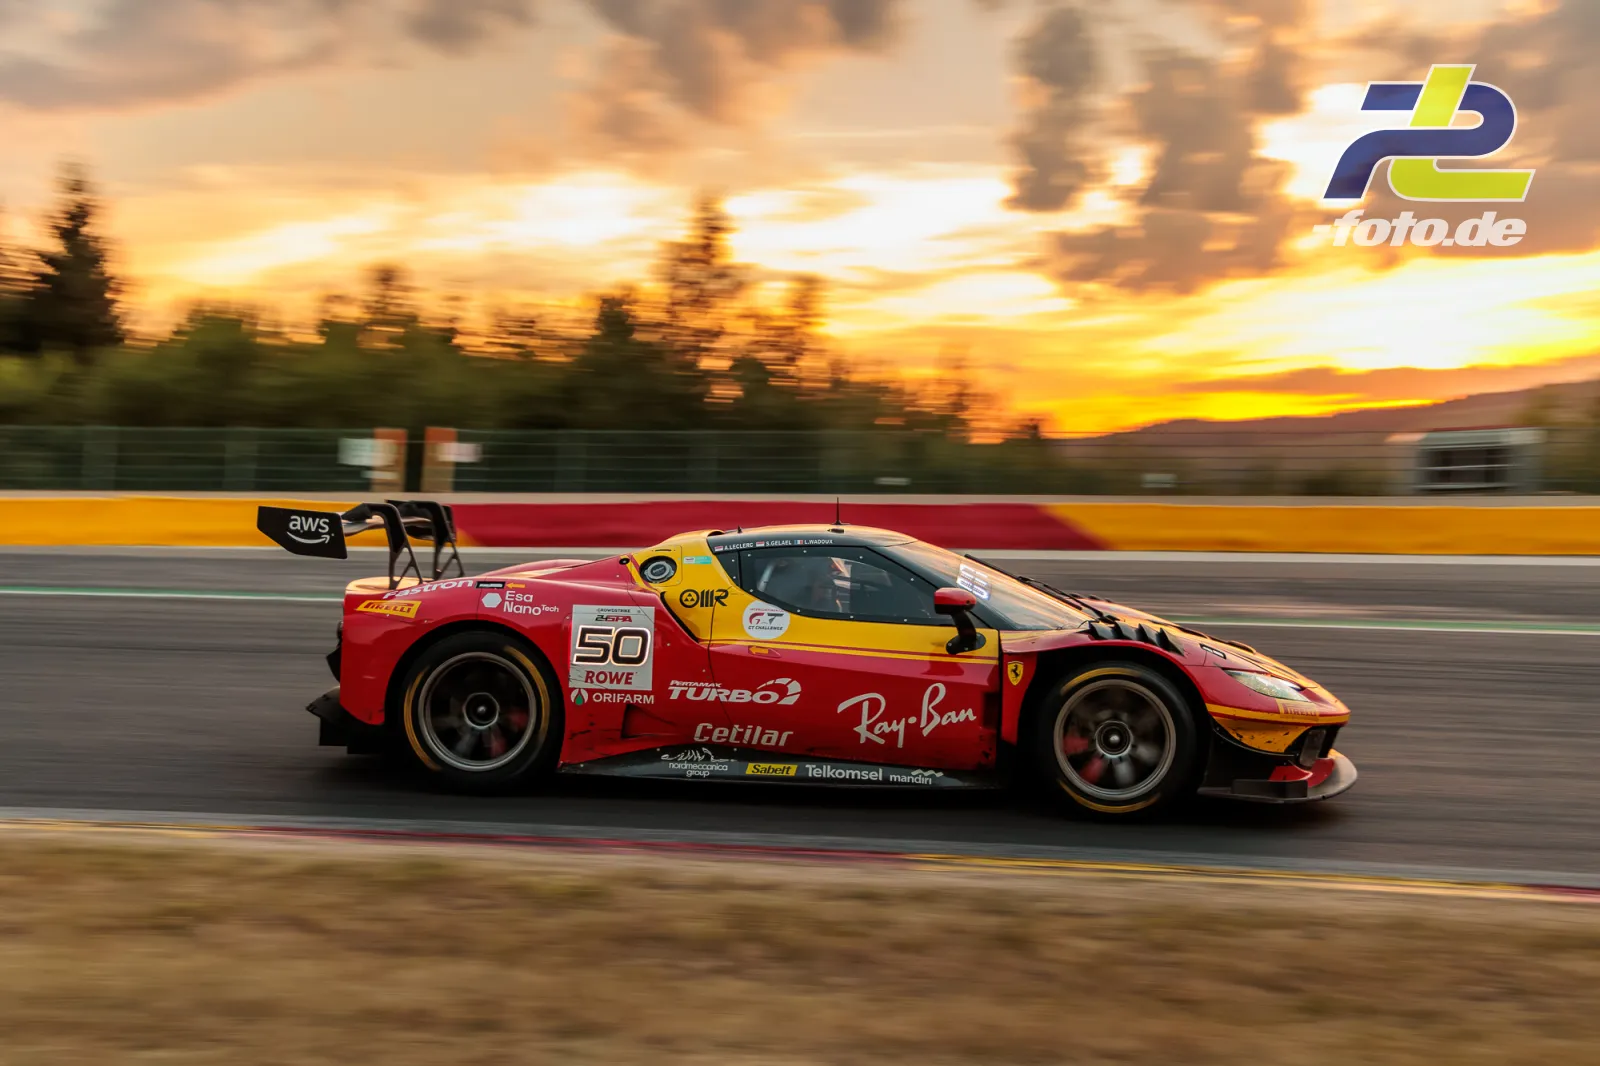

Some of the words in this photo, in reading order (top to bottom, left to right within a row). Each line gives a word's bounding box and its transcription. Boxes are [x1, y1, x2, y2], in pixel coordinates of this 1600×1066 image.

[288, 515, 330, 533] aws
[382, 579, 474, 600] Fastron
[505, 590, 534, 602] Esa
[363, 601, 415, 614] PIRELLI
[573, 625, 651, 667] 50
[584, 670, 634, 685] ROWE
[592, 692, 655, 705] ORIFARM
[668, 686, 780, 704] TURBO
[693, 722, 794, 747] Cetilar
[668, 761, 729, 771] nordmeccanica
[751, 764, 792, 775] Sabelt
[805, 764, 883, 781] Telkomsel
[686, 769, 711, 778] group
[889, 774, 932, 785] mandiri
